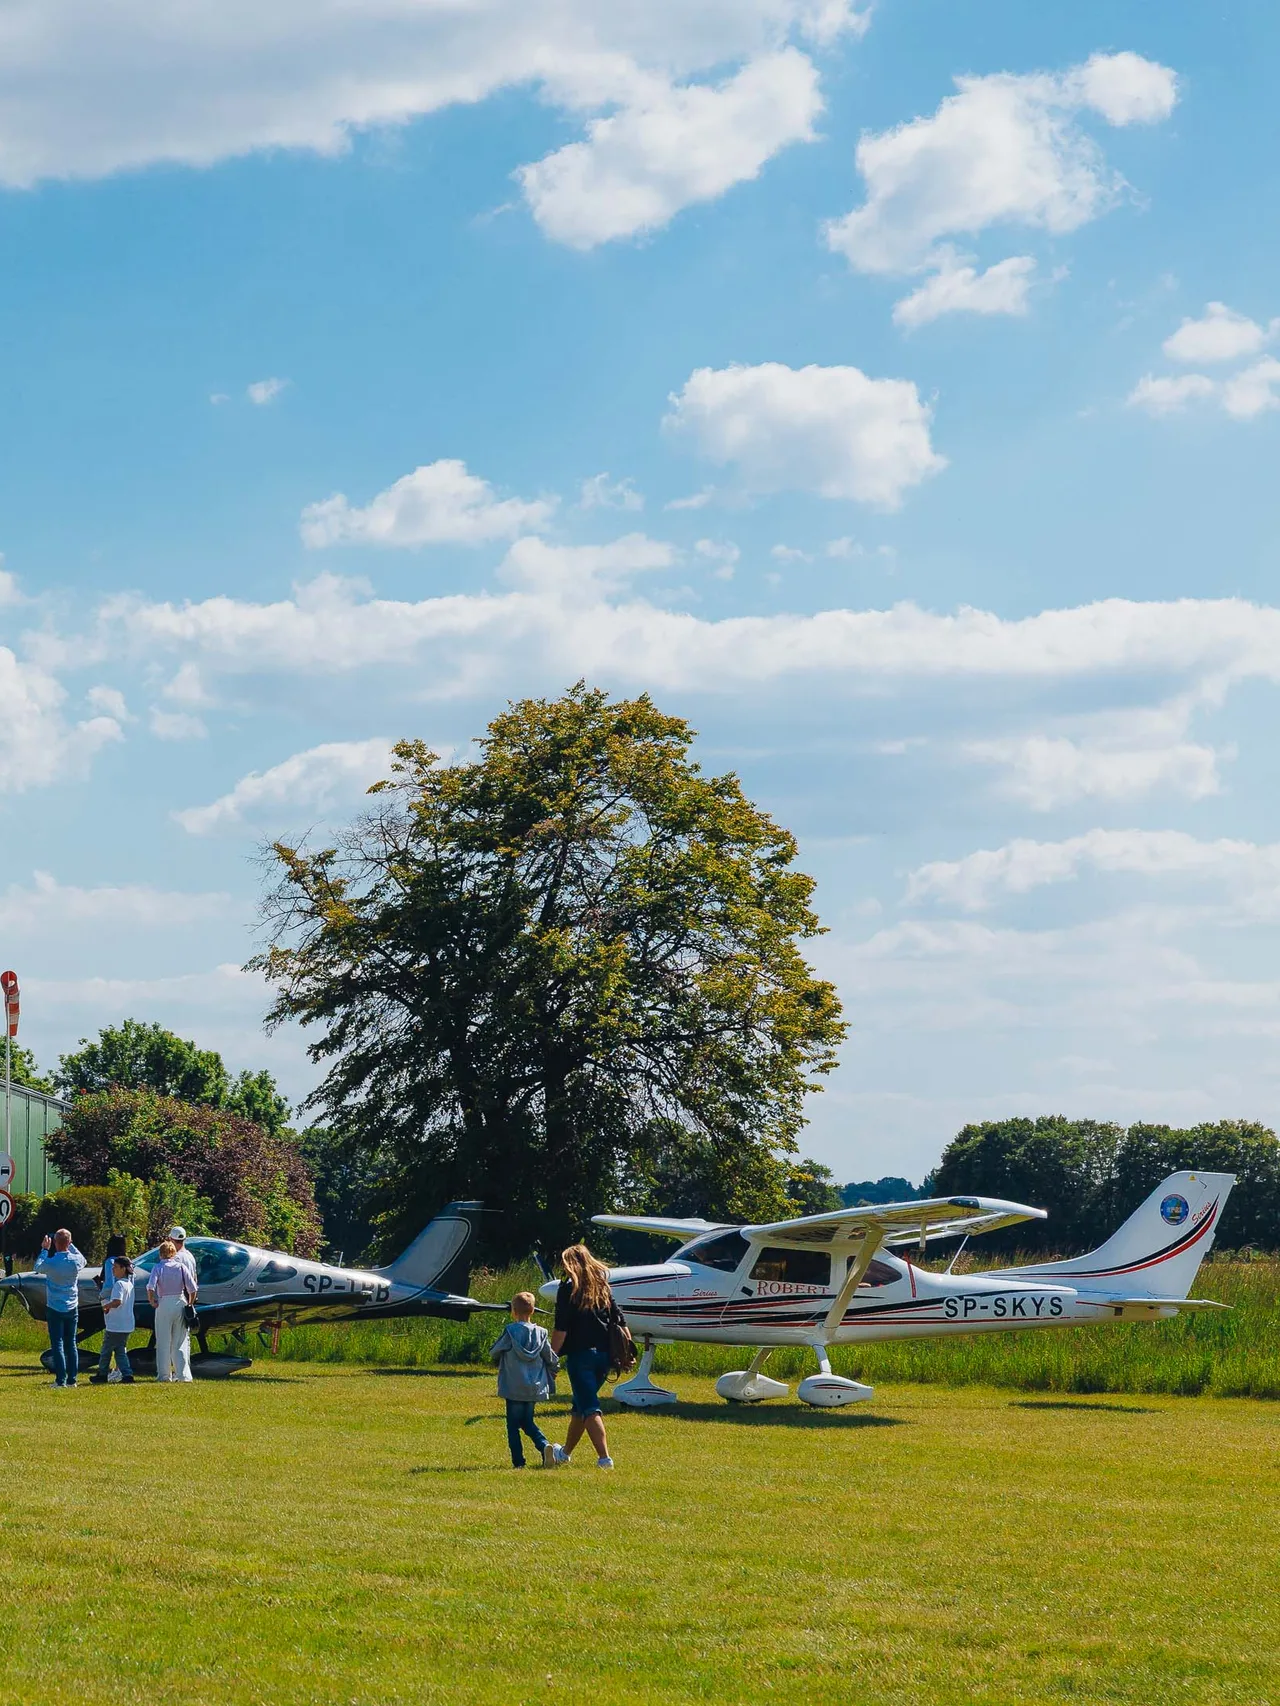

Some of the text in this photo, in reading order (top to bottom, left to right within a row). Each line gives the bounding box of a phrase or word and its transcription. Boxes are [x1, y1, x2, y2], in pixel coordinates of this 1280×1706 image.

[692, 1288, 718, 1297] Sirius
[757, 1281, 830, 1296] ROBERT
[944, 1296, 1063, 1318] SP-SKYS
